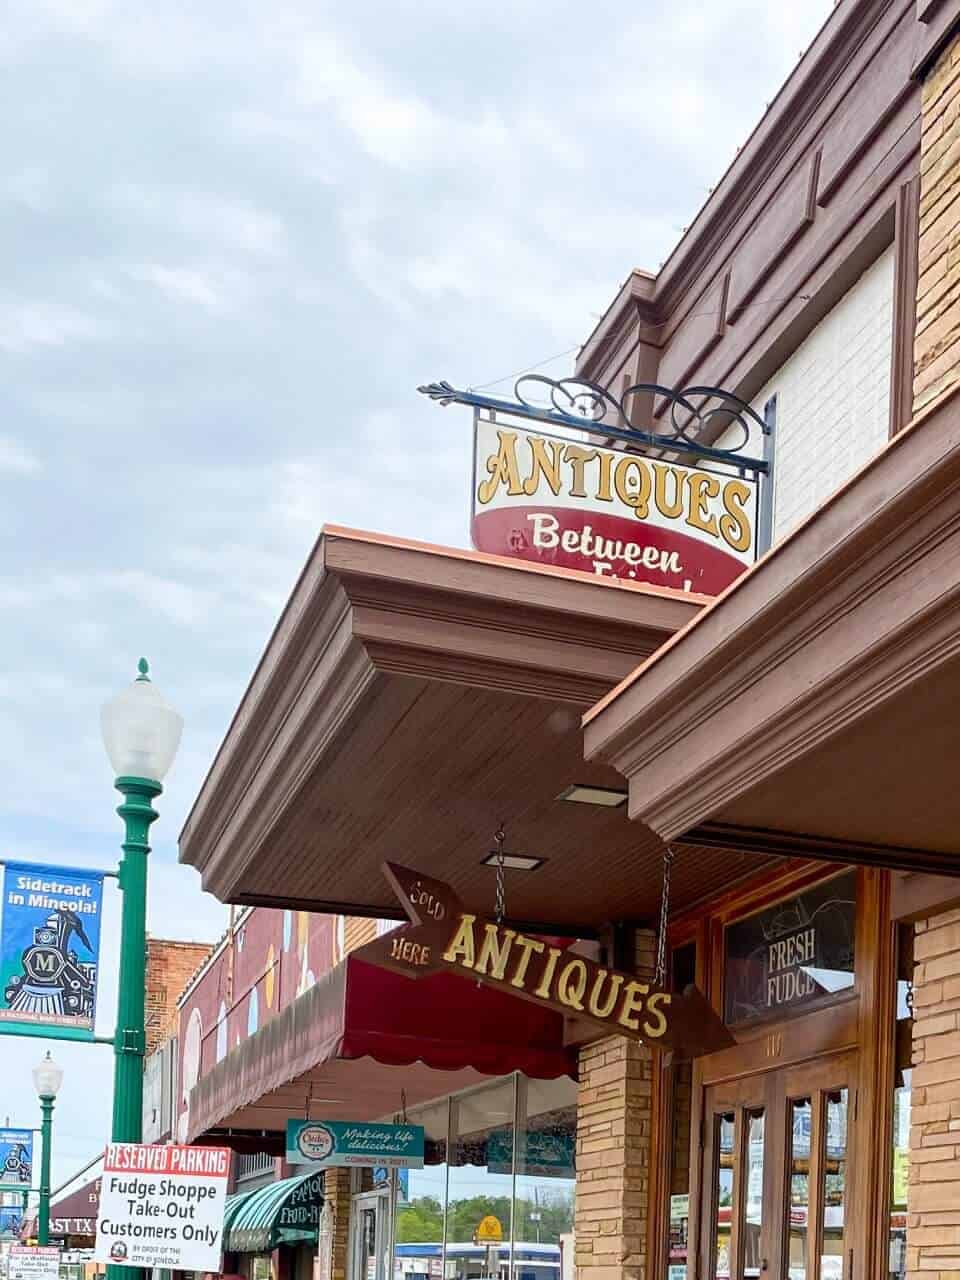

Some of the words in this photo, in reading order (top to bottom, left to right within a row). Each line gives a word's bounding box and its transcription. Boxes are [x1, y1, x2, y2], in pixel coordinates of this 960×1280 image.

[478, 430, 752, 552] ANTIQUES
[527, 513, 683, 573] Between
[17, 876, 92, 897] Sidetrack
[8, 892, 24, 905] in
[28, 894, 97, 914] Mineola!
[410, 881, 445, 921] SOLD
[35, 953, 55, 972] M
[391, 937, 431, 966] HERE
[768, 928, 815, 973] FRESH
[442, 913, 672, 1038] ANTIQUES
[767, 966, 816, 1007] FUDGE
[342, 1128, 392, 1142] Making
[395, 1130, 416, 1142] life
[348, 1140, 409, 1152] delicious!
[106, 1145, 168, 1169] RESERVED
[170, 1148, 227, 1172] PARKING
[110, 1178, 156, 1199] Fudge
[159, 1180, 217, 1202] Shoppe
[291, 1175, 326, 1205] FAMOU
[127, 1200, 195, 1219] Take-Out
[74, 1218, 92, 1233] TX
[100, 1219, 177, 1239] Customers
[182, 1224, 219, 1247] Only
